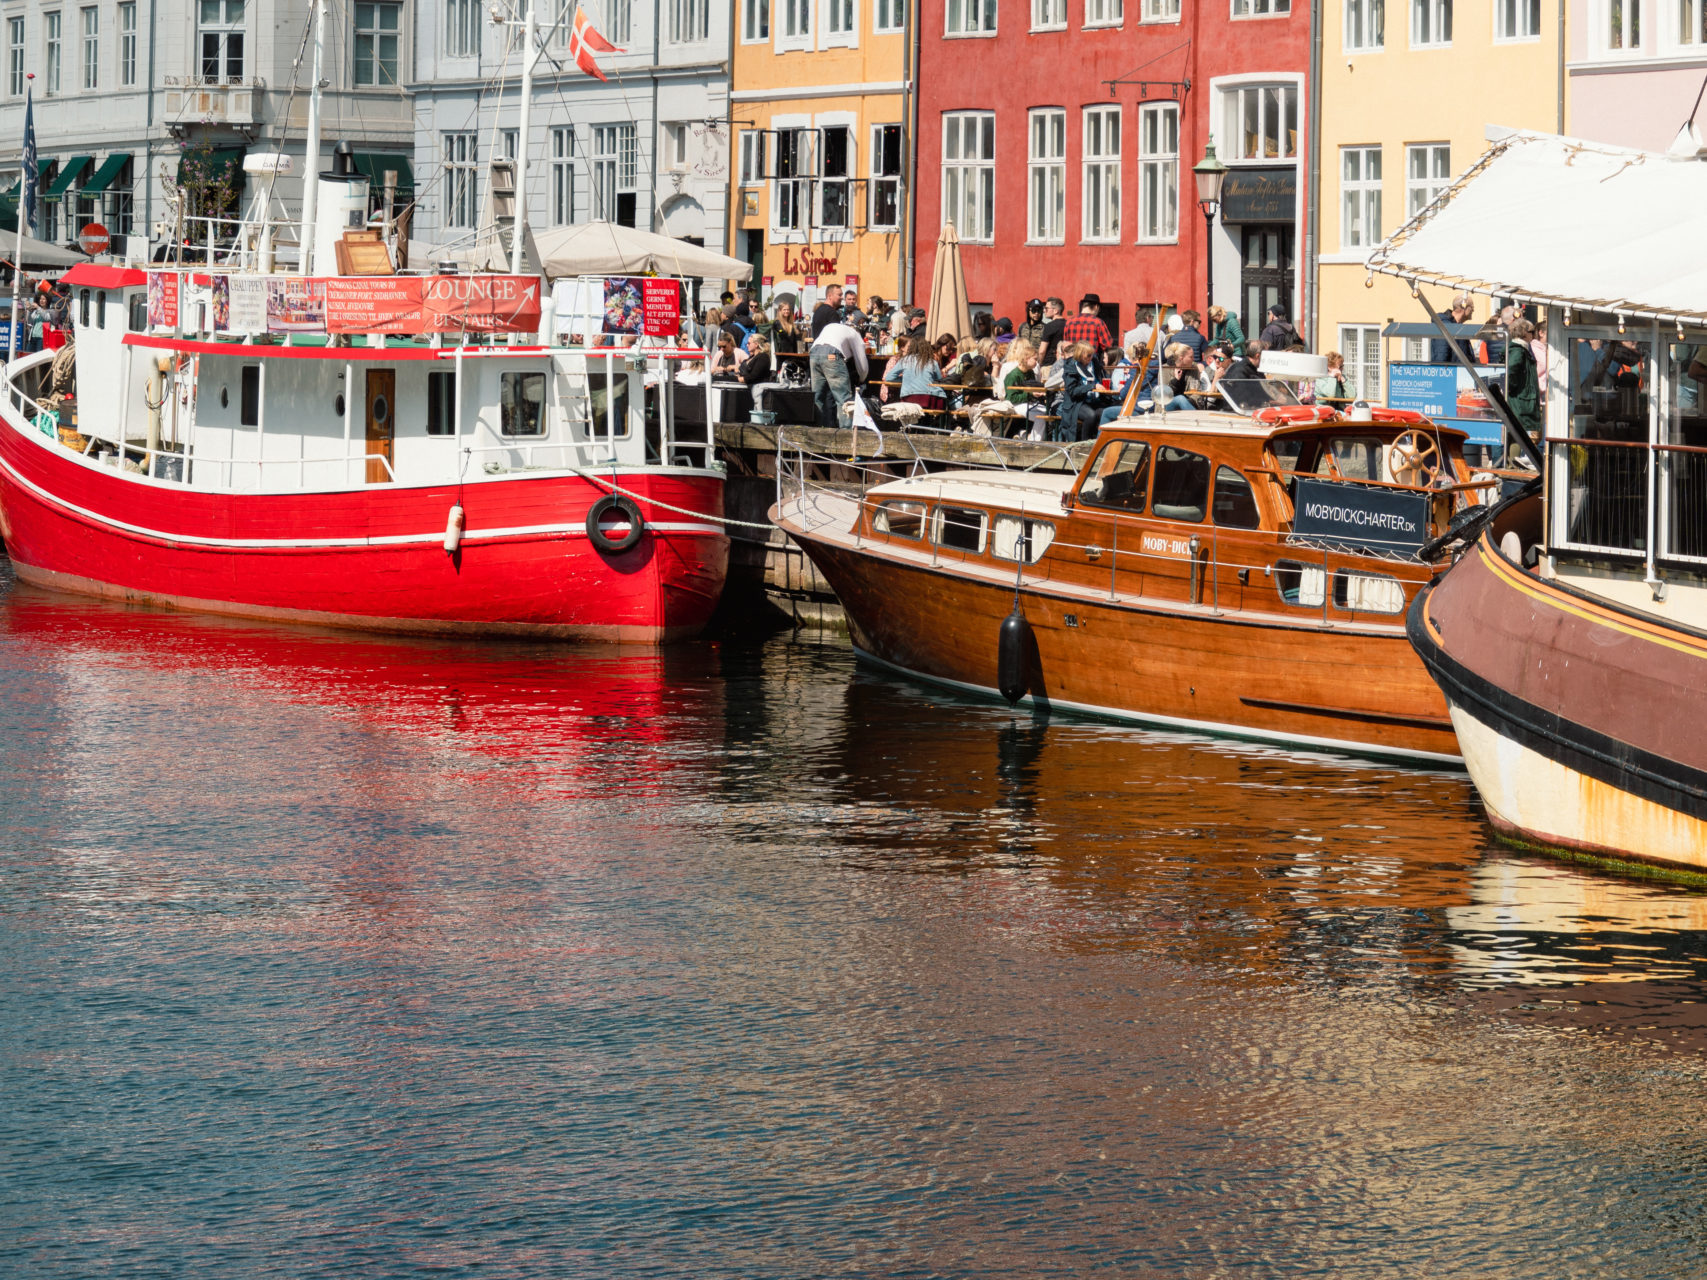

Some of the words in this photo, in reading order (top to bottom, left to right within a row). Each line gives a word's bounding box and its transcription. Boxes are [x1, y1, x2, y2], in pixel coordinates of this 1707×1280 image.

[783, 247, 798, 275] La
[800, 246, 838, 275] Sirène
[427, 279, 517, 301] LOUNGE
[433, 313, 504, 328] UPSTAIRS
[1392, 366, 1403, 376] THE
[1403, 366, 1421, 377] YACHT
[1421, 367, 1439, 377] MOBY
[1439, 367, 1454, 377] DICK
[1305, 502, 1416, 533] MOBYDICKCHARTER.DK
